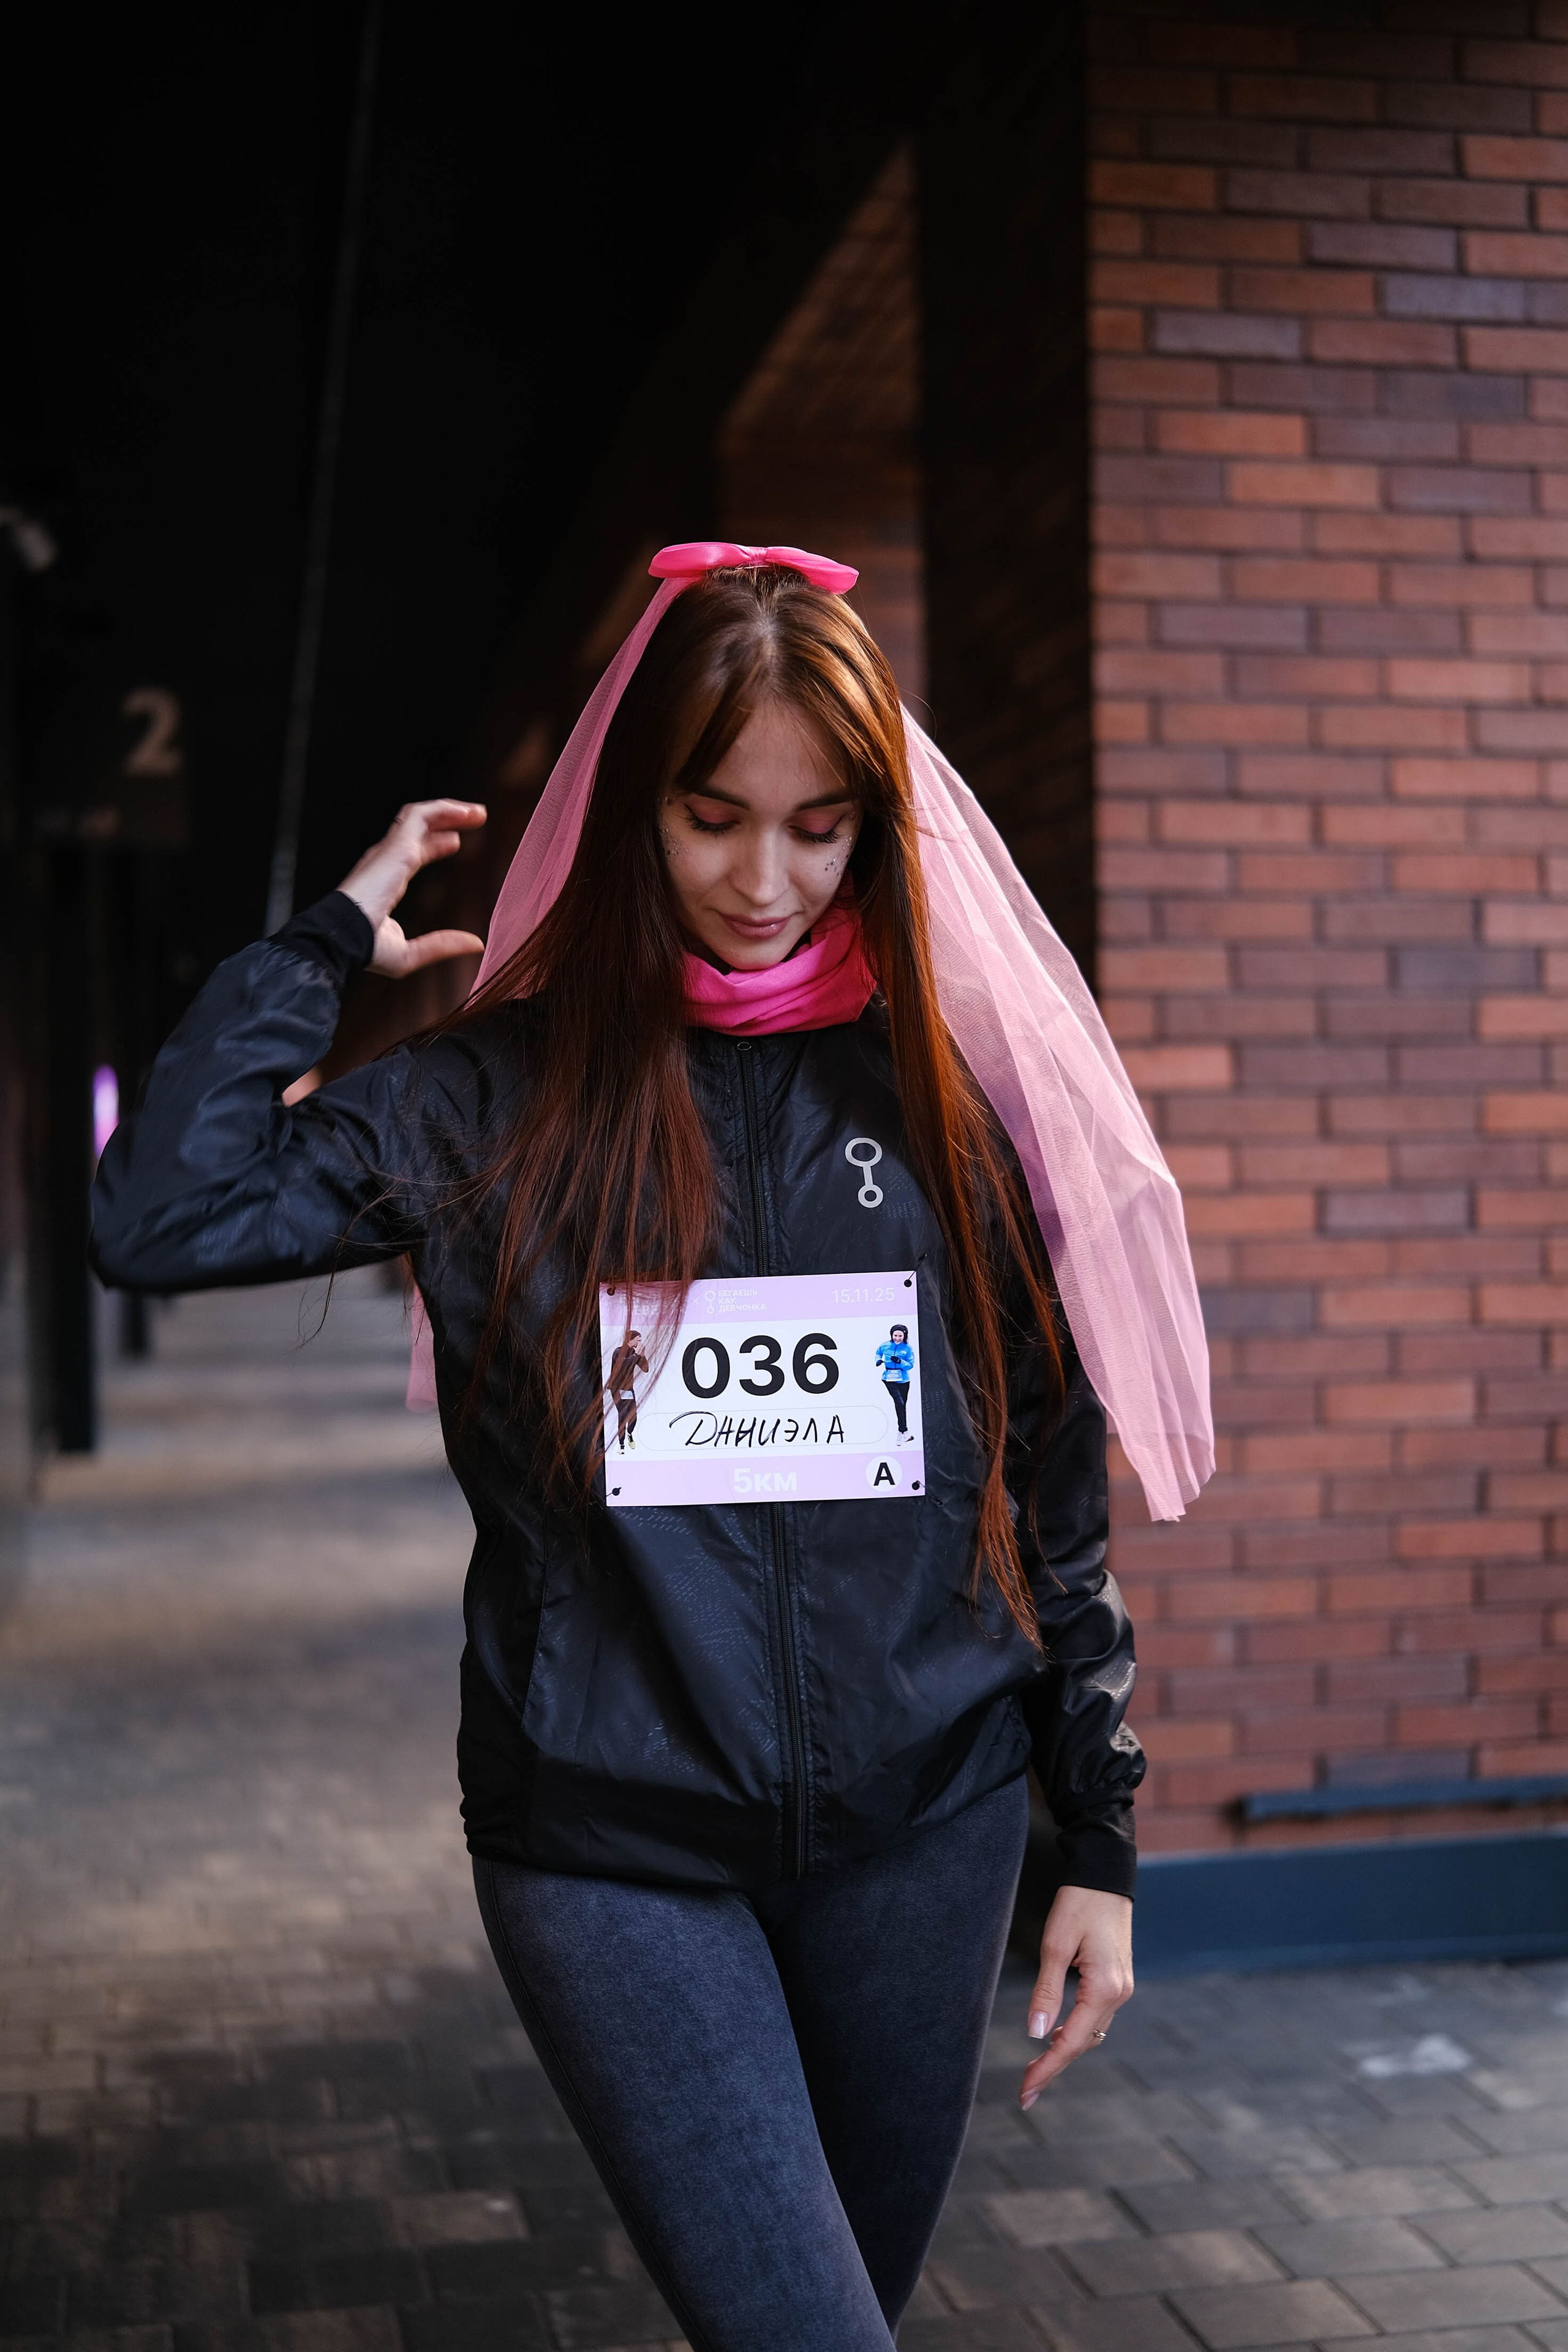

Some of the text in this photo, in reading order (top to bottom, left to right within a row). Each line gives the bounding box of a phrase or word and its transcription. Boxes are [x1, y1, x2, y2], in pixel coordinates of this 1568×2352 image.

[121, 685, 183, 776] 2
[718, 1303, 767, 1313] ДЕВЧОНКА
[832, 1287, 895, 1303] 15.11.25
[681, 1332, 839, 1399] 036
